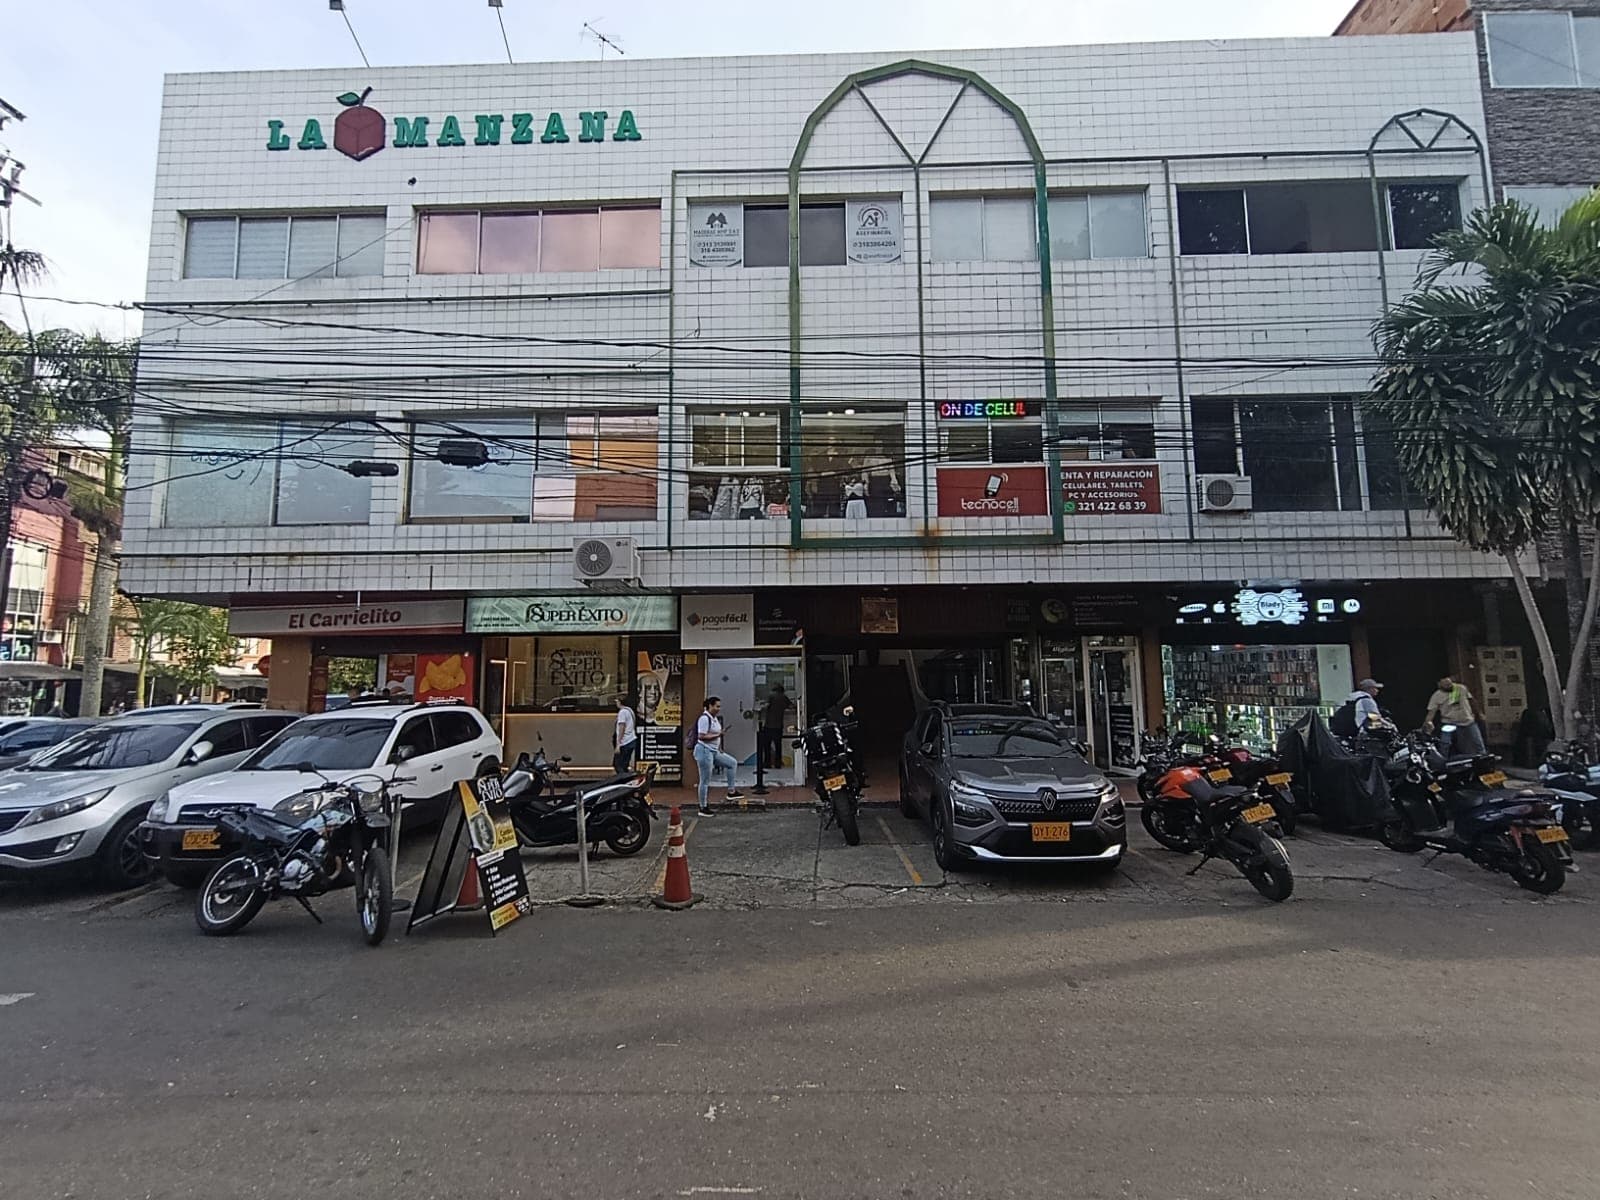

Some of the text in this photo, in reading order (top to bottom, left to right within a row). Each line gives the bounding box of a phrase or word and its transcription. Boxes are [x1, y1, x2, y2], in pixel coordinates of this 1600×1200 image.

[266, 109, 642, 151] LA MANZANA
[964, 403, 983, 417] DE
[1060, 469, 1153, 481] ENTA Y REPARACIÓN
[1068, 492, 1079, 500] PC
[1080, 492, 1086, 500] Y
[961, 497, 1019, 511] tecnocell
[1078, 501, 1147, 512] 321 422 68 39
[288, 608, 402, 629] El Carrielito
